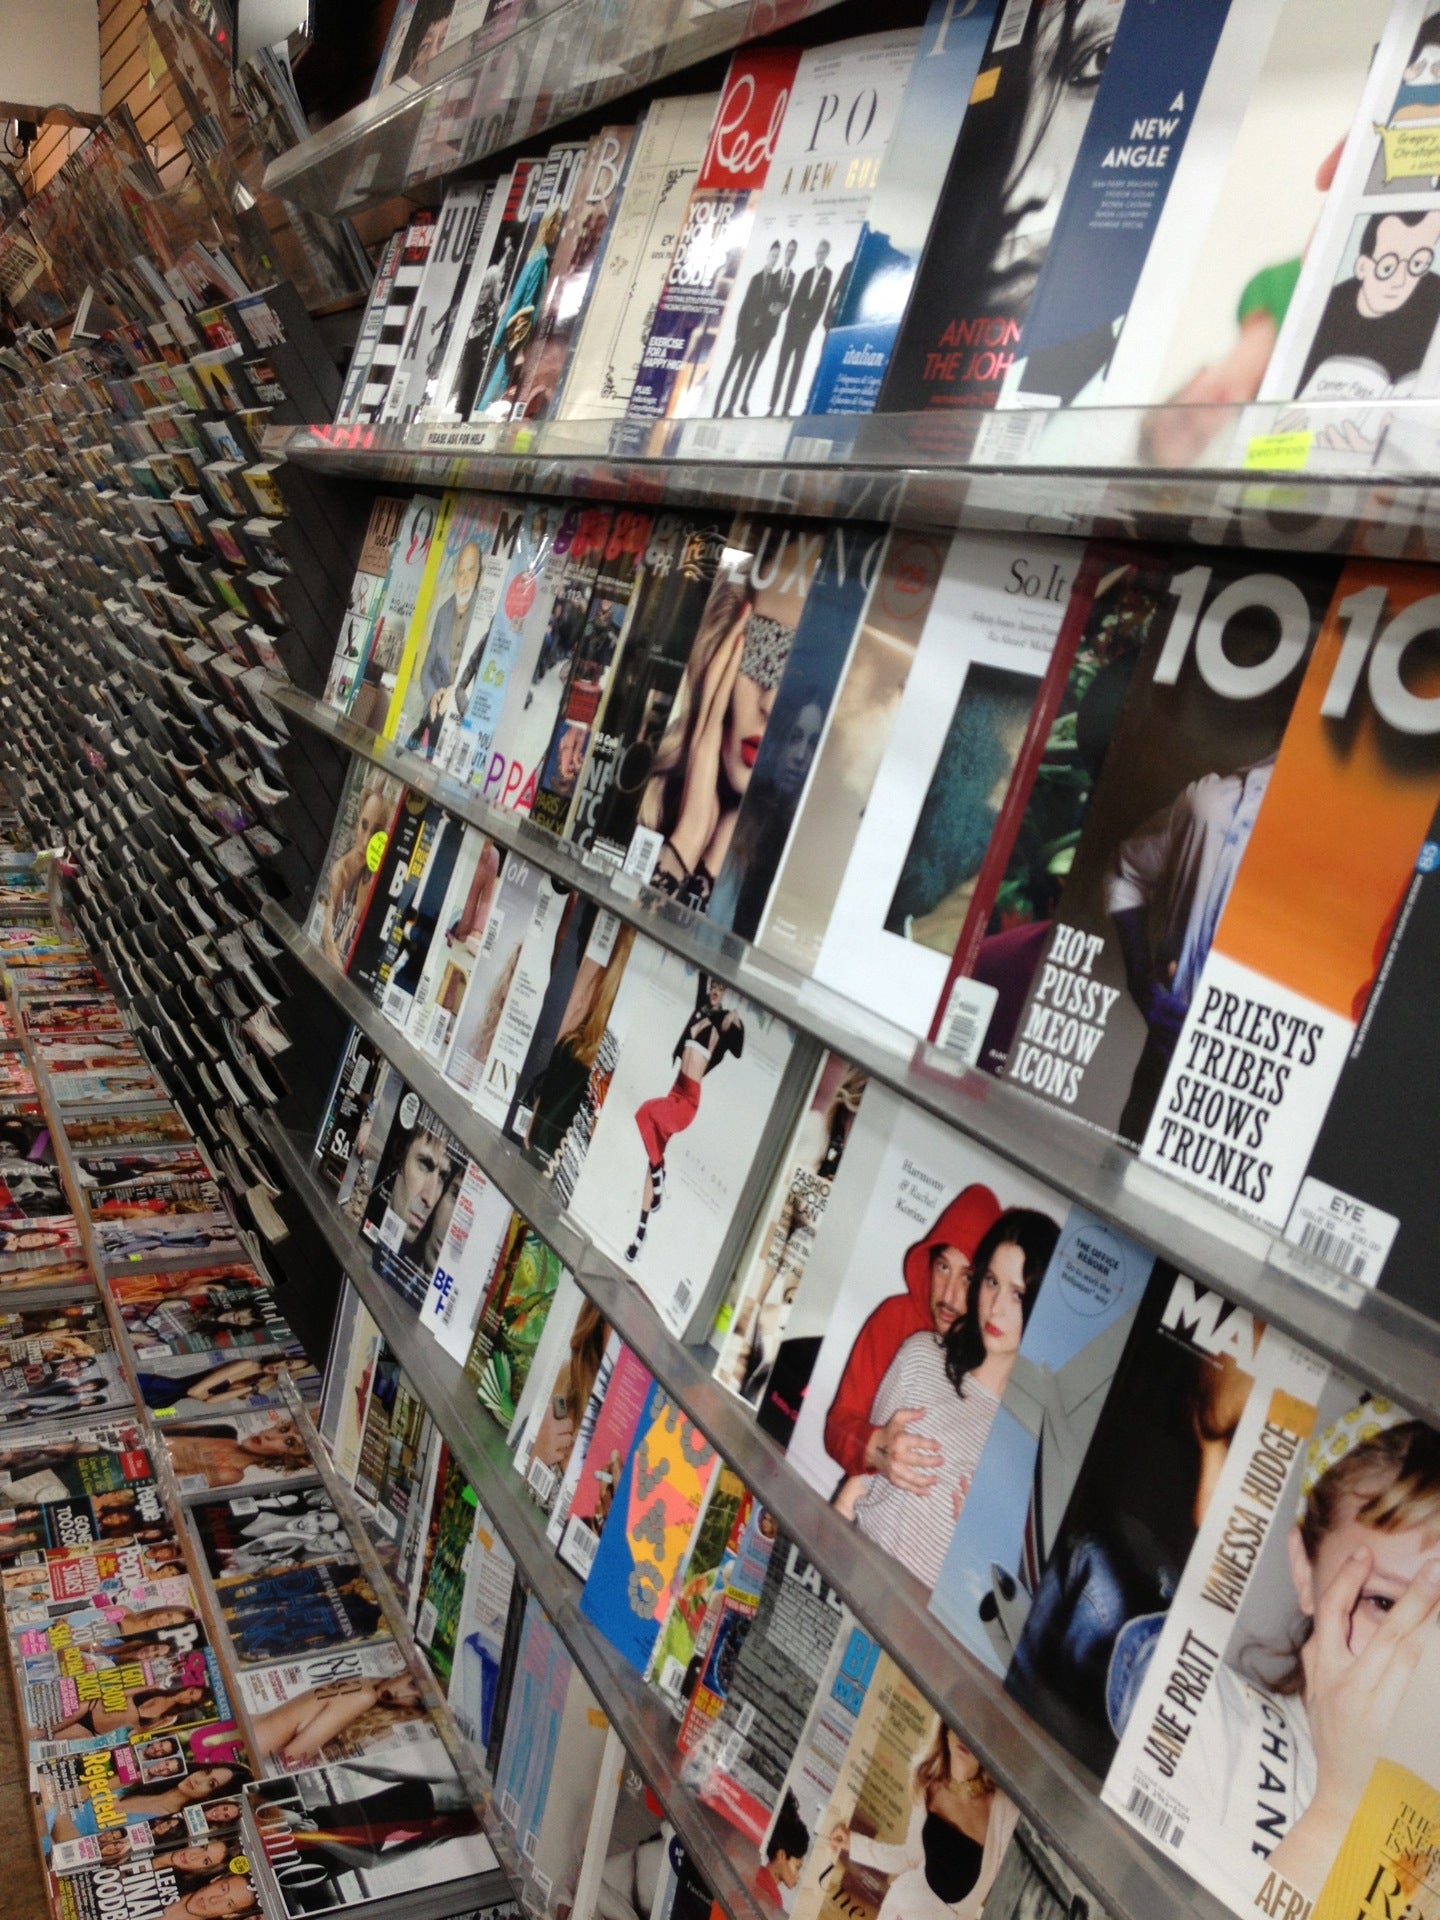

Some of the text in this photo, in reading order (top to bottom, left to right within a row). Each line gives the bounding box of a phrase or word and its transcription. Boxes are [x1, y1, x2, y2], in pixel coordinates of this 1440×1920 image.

[1169, 90, 1184, 111] A
[703, 73, 788, 180] Red
[1130, 118, 1180, 140] NEW
[1101, 145, 1170, 168] ANGLE
[781, 168, 794, 196] A
[800, 160, 838, 193] NEW
[688, 202, 735, 226] YOUR
[649, 336, 686, 351] EXERCISE
[643, 357, 666, 370] HAPPY
[923, 354, 959, 383] THE
[427, 430, 486, 446] PLEASE ASK FOR HELP
[1004, 556, 1042, 598] So
[1153, 563, 1313, 700] 10
[1320, 584, 1440, 737] 10
[1049, 923, 1105, 977] HOT
[1035, 963, 1121, 1026] PUSSY
[1022, 1002, 1105, 1067] MEOW
[1197, 984, 1326, 1068] PRIESTS
[1009, 1041, 1086, 1106] ICONS
[1176, 1029, 1292, 1107] TRIBES
[1168, 1074, 1271, 1151] SHOWS
[1155, 1117, 1274, 1205] TRUNKS
[1329, 1194, 1366, 1225] EYE
[1074, 1237, 1094, 1258] THE
[55, 1505, 74, 1529] TOO
[133, 1484, 163, 1523] People
[73, 1514, 93, 1543] GONE
[1200, 1502, 1272, 1615] VANESSA
[60, 1563, 84, 1594] STARS!
[74, 1672, 101, 1702] BACK!
[97, 1667, 126, 1714] MY BODY
[121, 1666, 145, 1688] GOT
[328, 1652, 365, 1695] Rita
[215, 1692, 231, 1719] KATE!
[1142, 1626, 1221, 1780] JANE PRATT
[79, 1750, 127, 1830] Rejected!
[154, 1868, 180, 1906] LEA'S
